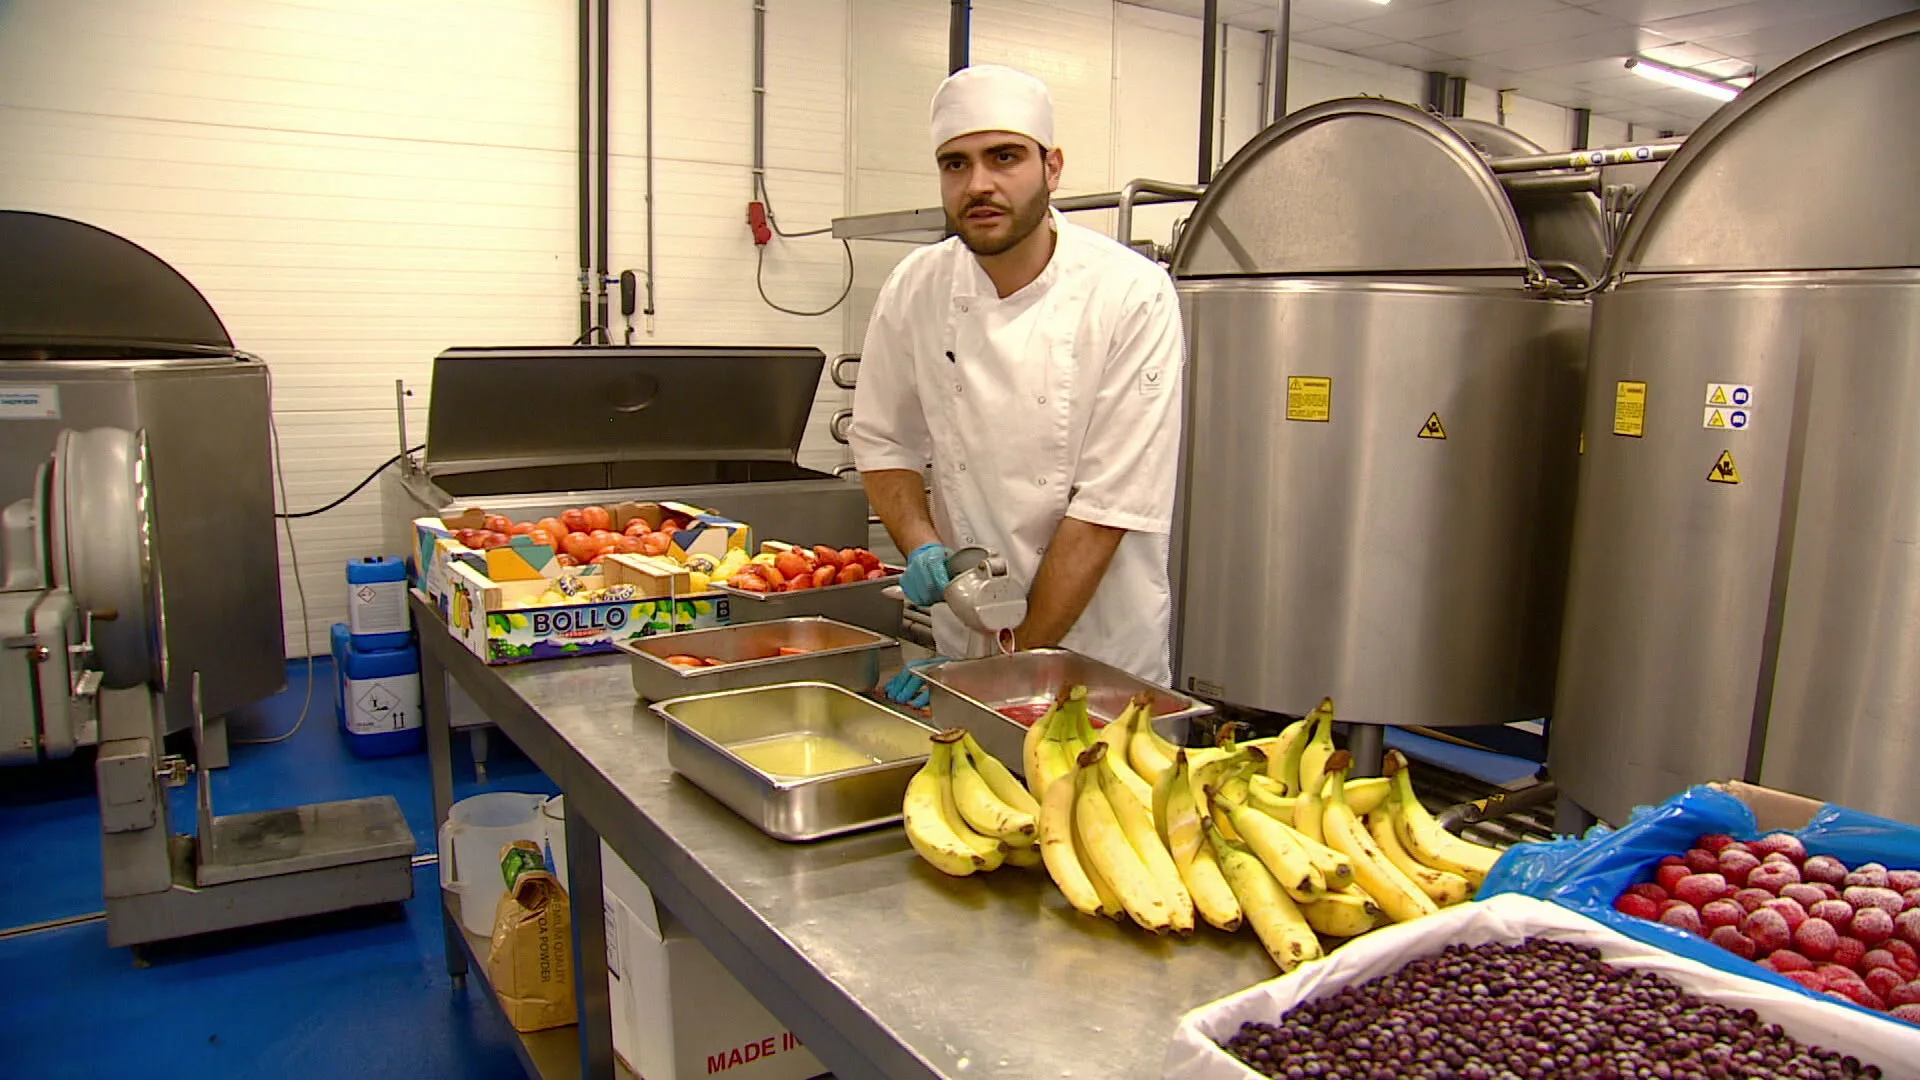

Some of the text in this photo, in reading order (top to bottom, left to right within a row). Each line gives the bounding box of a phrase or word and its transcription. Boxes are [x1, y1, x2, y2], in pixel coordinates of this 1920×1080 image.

[533, 607, 626, 634] BOLLO
[540, 936, 551, 982] POWDER
[553, 941, 565, 984] QUALITY
[707, 1037, 776, 1075] MADE
